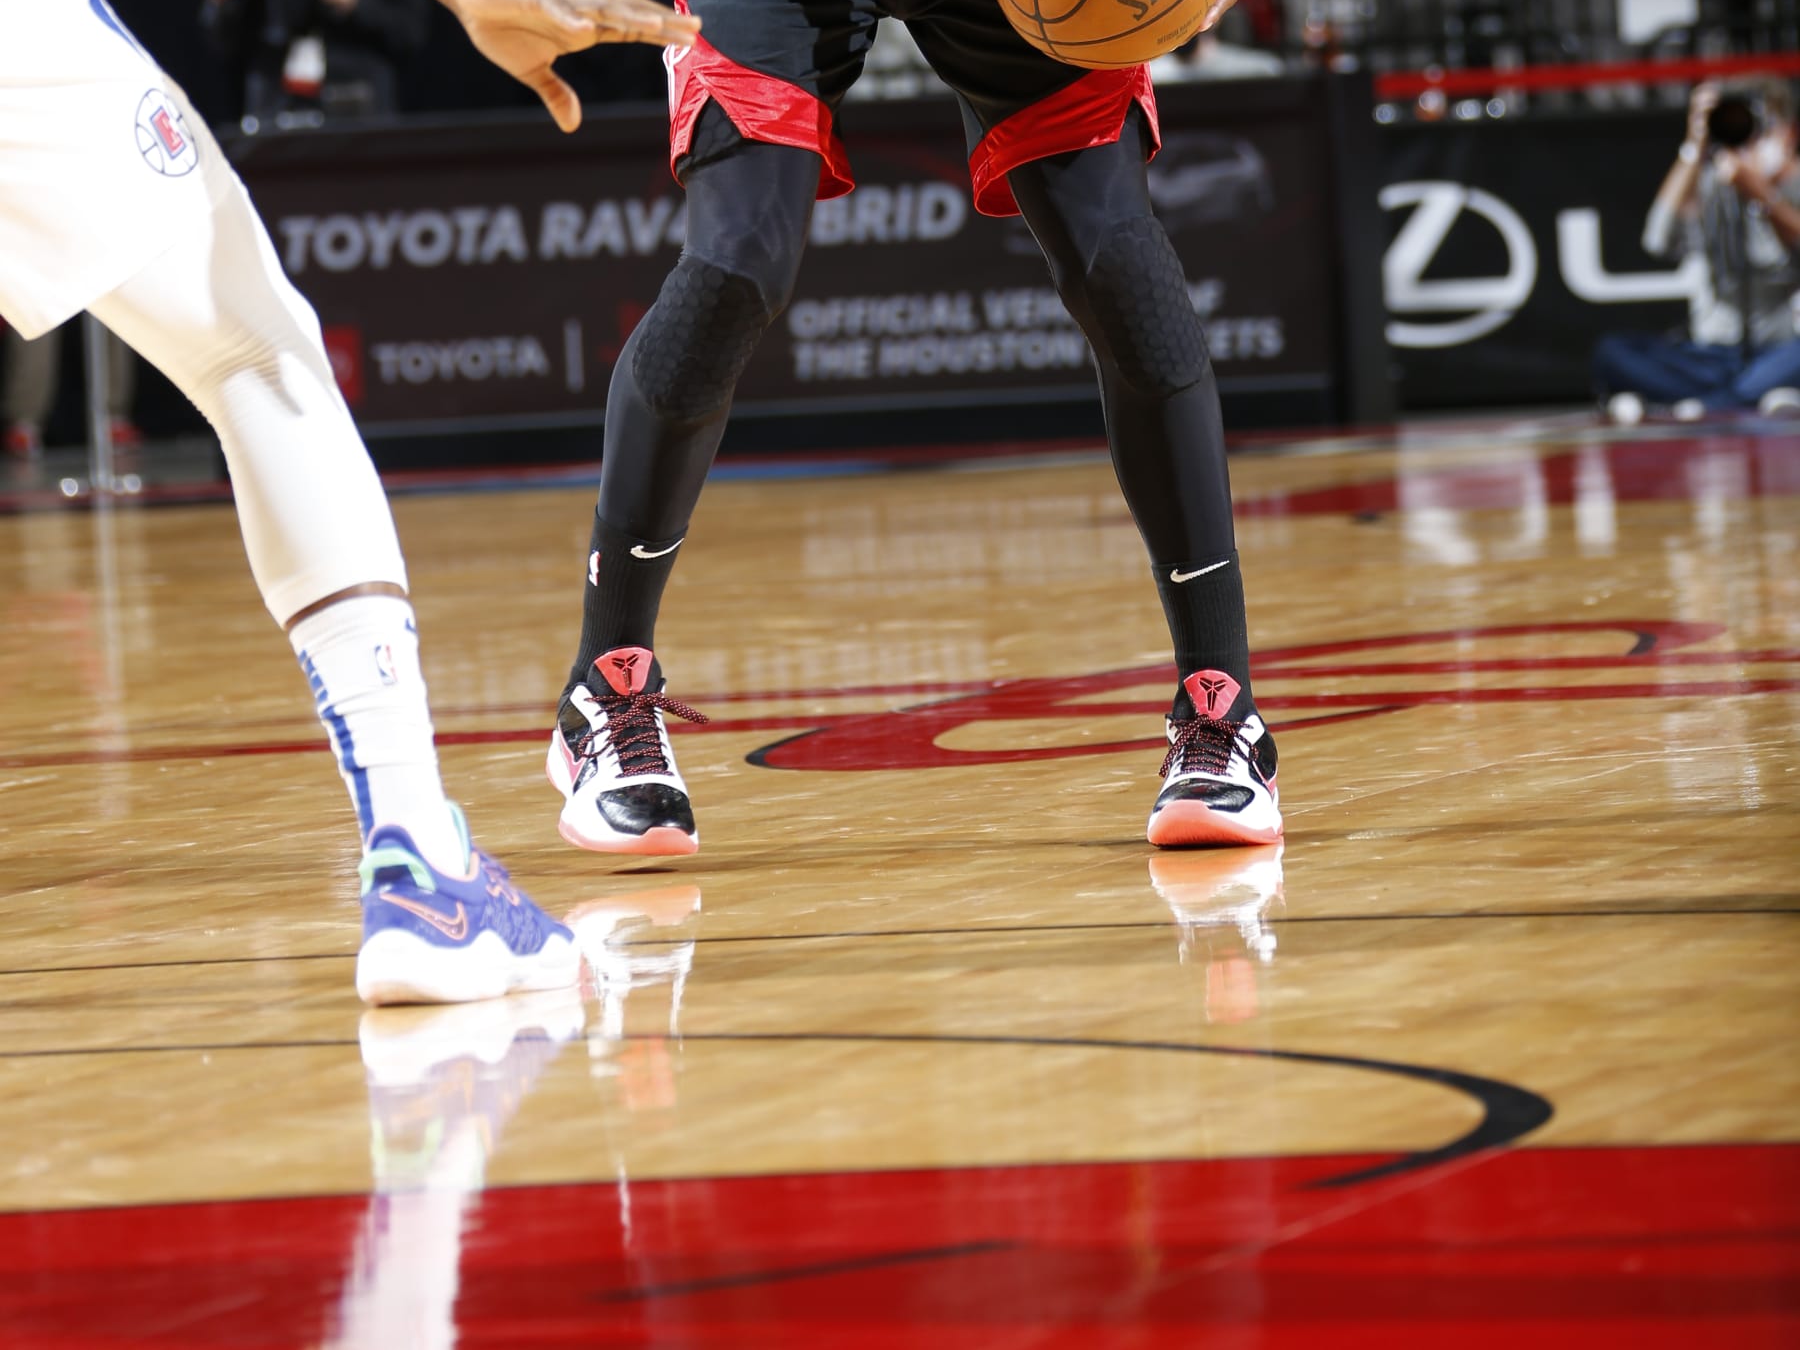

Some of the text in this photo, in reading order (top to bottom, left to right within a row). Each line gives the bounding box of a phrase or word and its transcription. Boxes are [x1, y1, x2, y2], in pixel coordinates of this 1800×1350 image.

[280, 206, 527, 271] TOYOTA
[809, 181, 967, 246] BRID
[788, 290, 976, 338] OFFICIAL
[371, 338, 548, 385] TOYOTA
[793, 329, 1086, 382] THE HOUSTON
